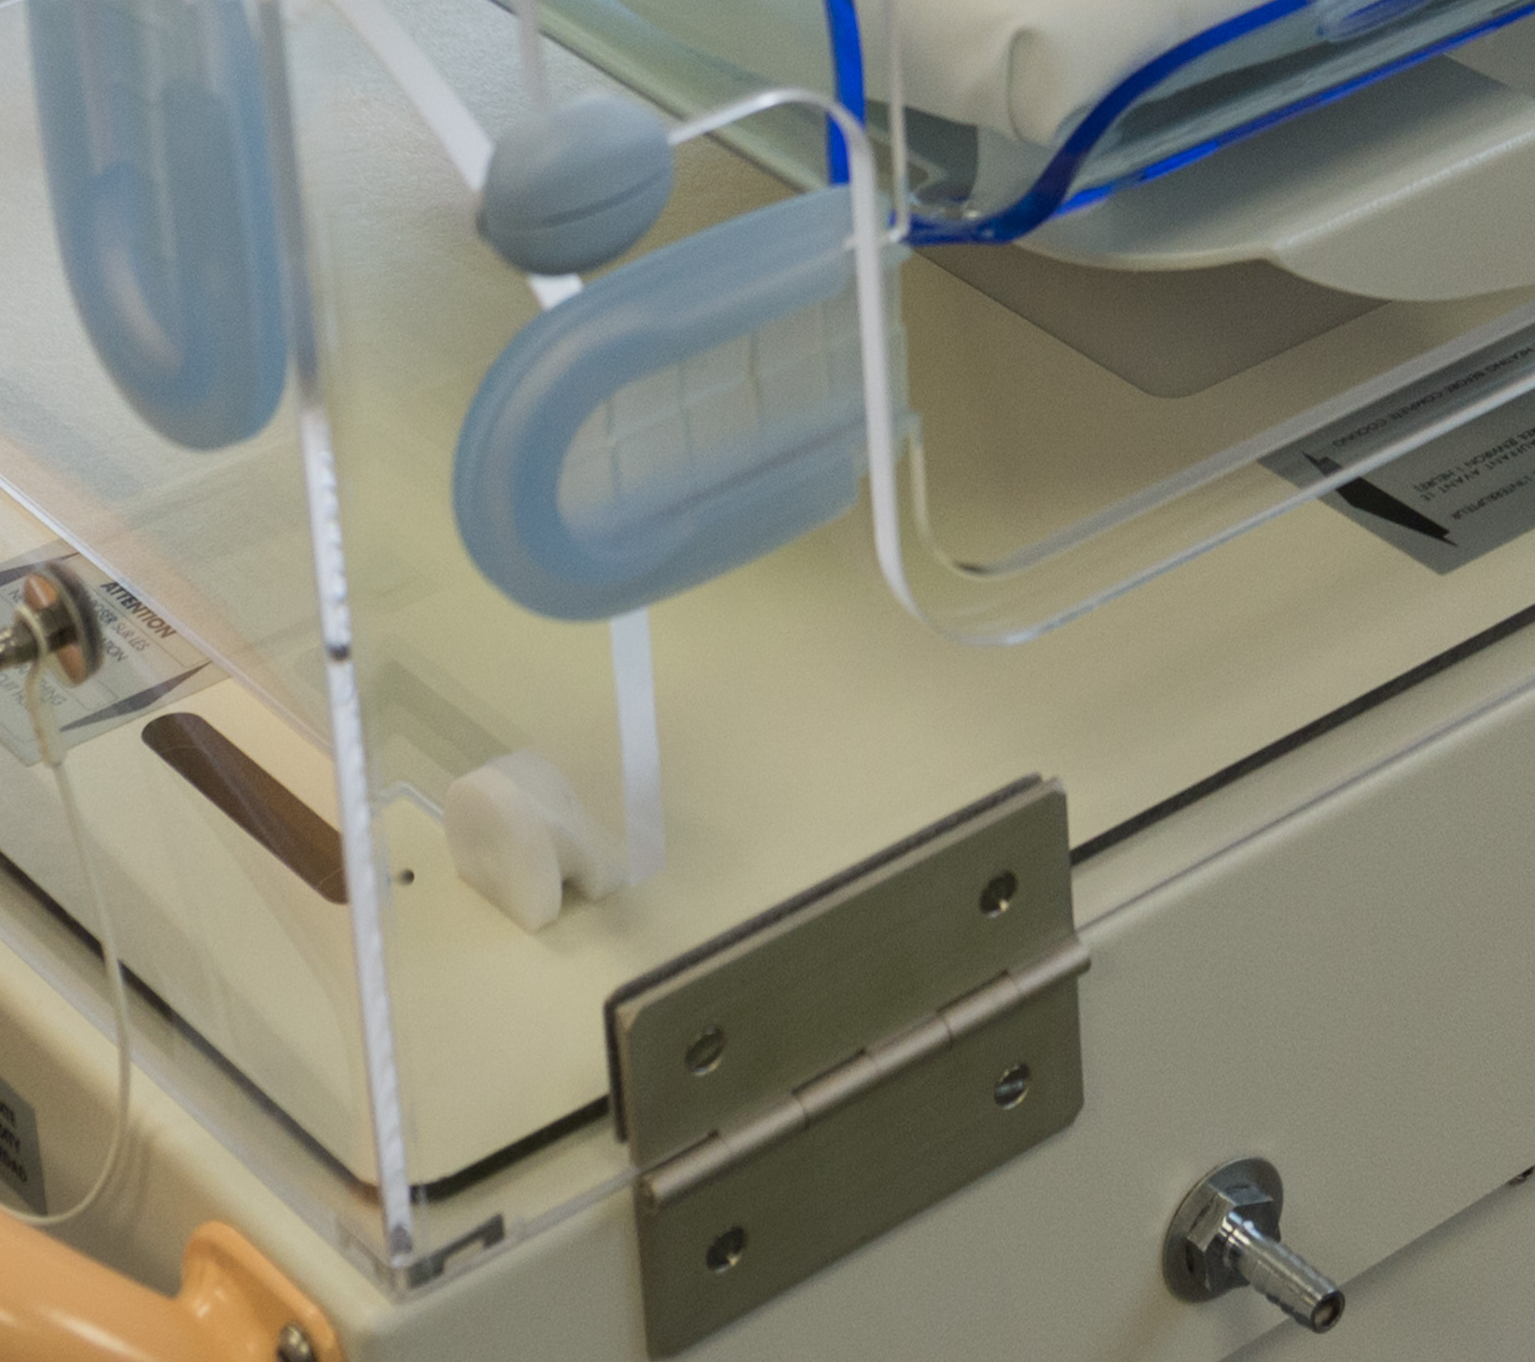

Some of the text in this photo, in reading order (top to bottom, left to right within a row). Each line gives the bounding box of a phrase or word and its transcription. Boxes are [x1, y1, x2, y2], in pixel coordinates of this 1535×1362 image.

[1481, 345, 1535, 373] HEATING
[1441, 369, 1487, 393] BEFORE
[1385, 389, 1447, 421] COMPLETE
[1328, 416, 1391, 448] COOLING
[1434, 467, 1484, 494] AVANT
[1417, 490, 1439, 502] LE
[1447, 474, 1535, 521] L'INTERRUPTEUR
[97, 580, 177, 639] ATTENTION
[108, 622, 137, 639] SUR
[125, 635, 152, 652] LES
